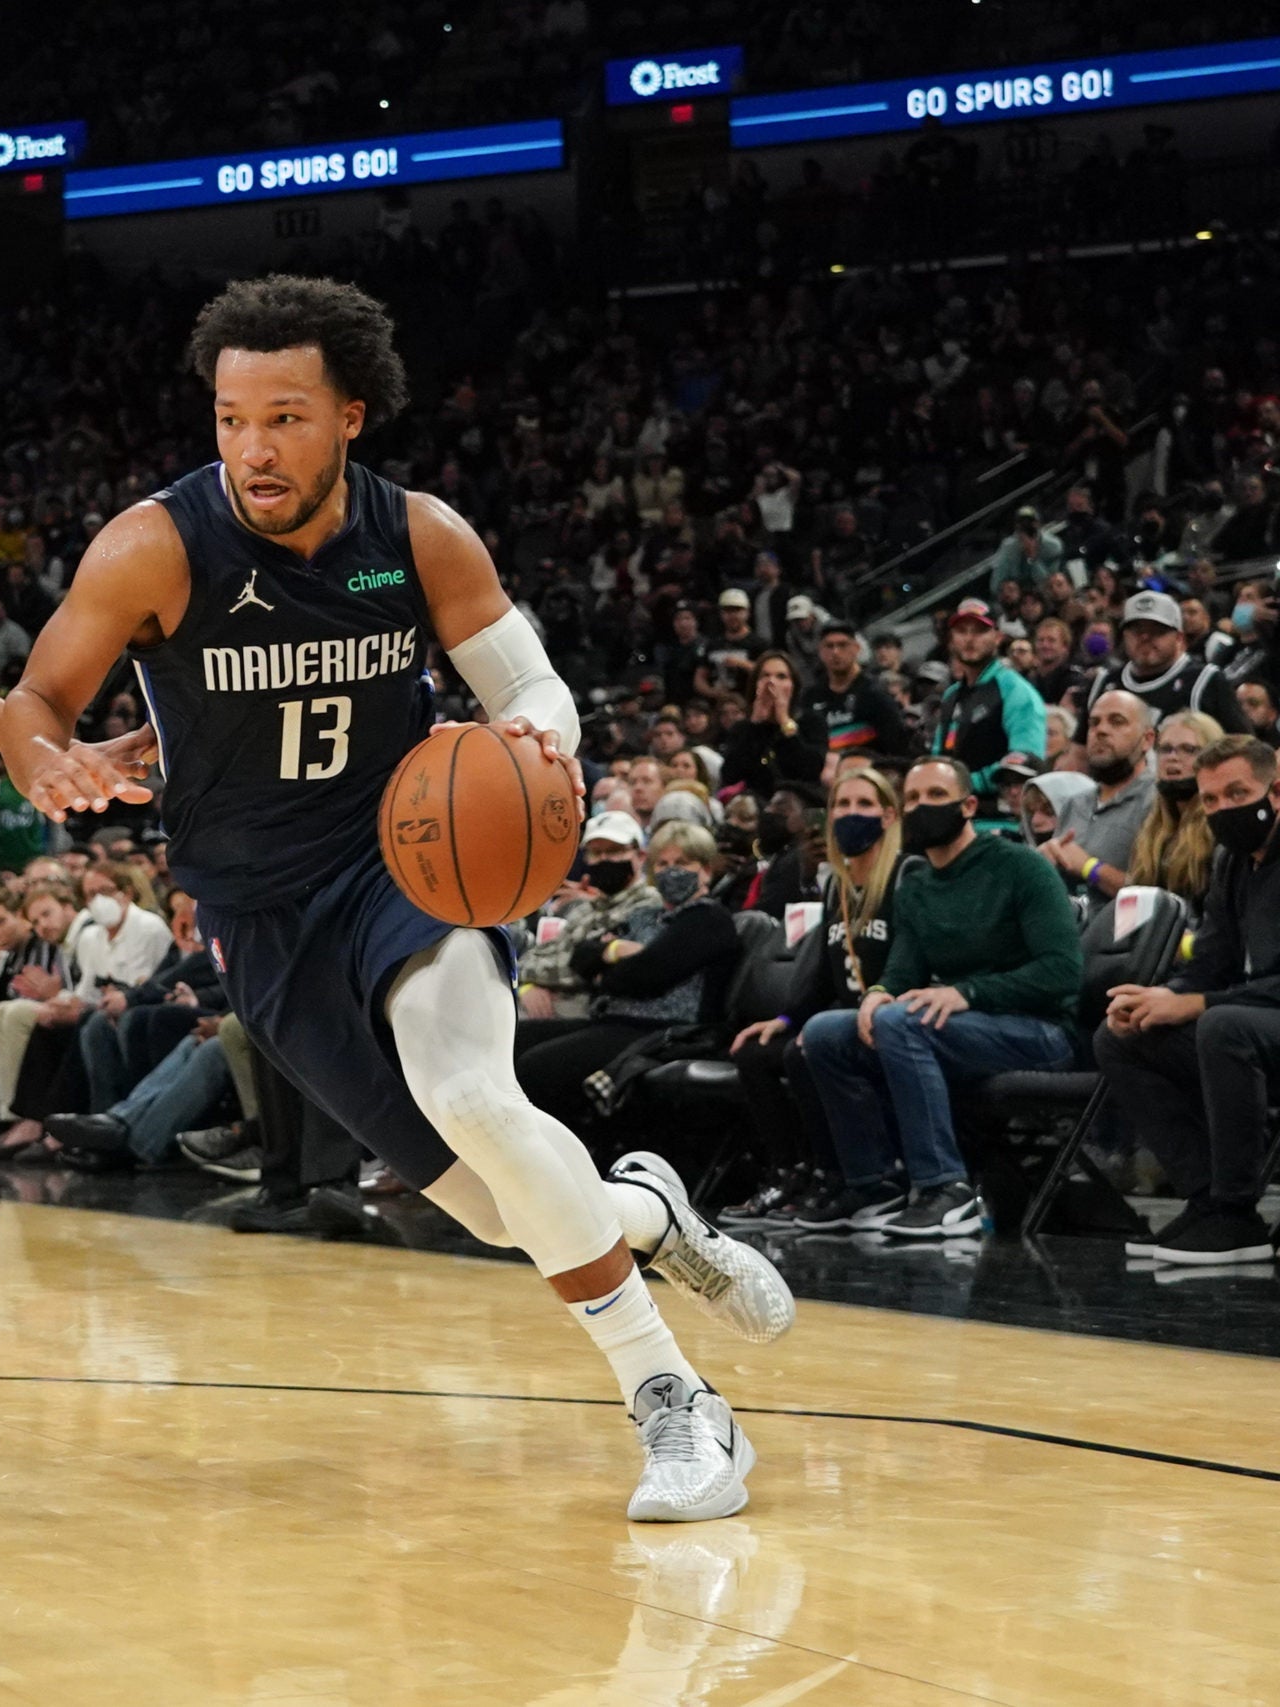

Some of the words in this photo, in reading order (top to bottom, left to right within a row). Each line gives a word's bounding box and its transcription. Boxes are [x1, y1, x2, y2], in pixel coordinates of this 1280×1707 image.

[663, 63, 719, 89] Frost
[906, 87, 946, 119] GO
[955, 77, 1053, 114] SPURS
[1061, 69, 1113, 102] GO!
[16, 134, 66, 160] Frost
[217, 165, 255, 194] GO
[260, 154, 346, 189] SPURS
[352, 148, 399, 178] GO!
[346, 567, 407, 594] chime
[202, 625, 418, 692] MAVERICKS
[278, 695, 353, 781] 13
